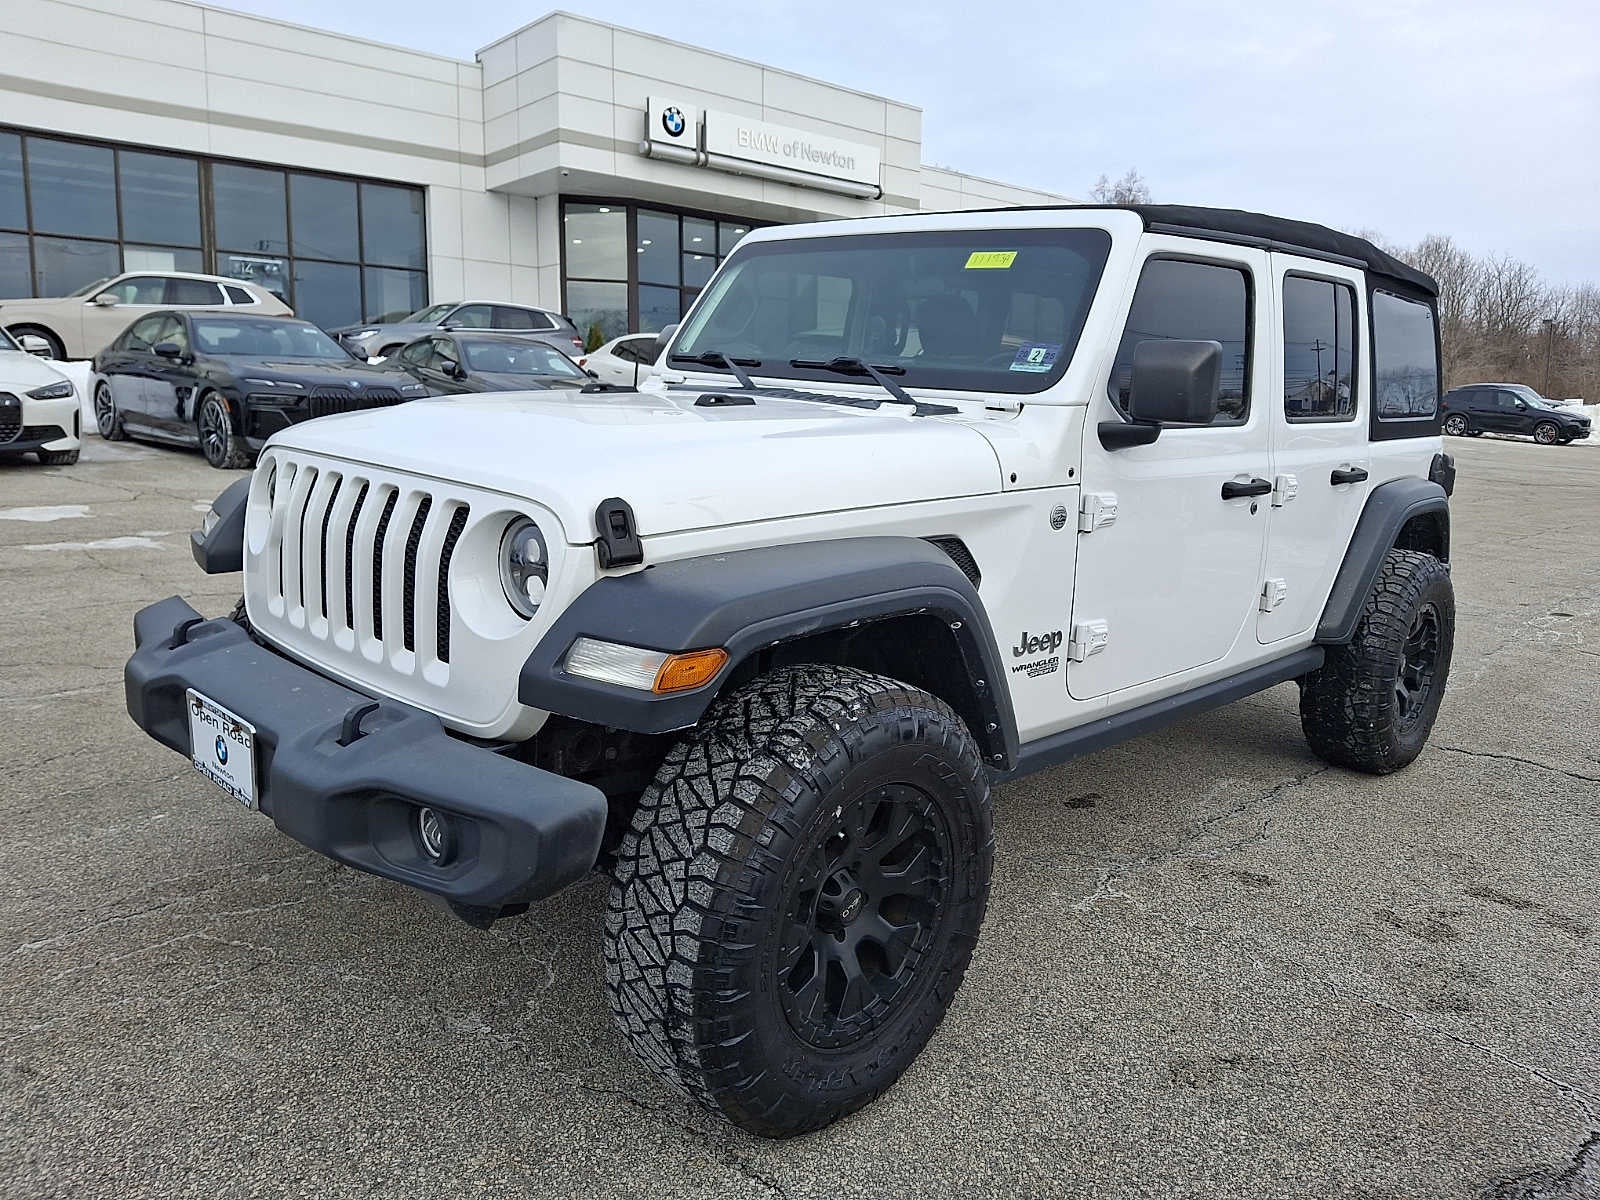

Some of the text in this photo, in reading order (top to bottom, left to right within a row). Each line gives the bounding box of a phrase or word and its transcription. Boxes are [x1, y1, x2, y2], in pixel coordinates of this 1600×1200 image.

[737, 127, 856, 170] BMW of Newton
[1031, 350, 1041, 361] 2
[1012, 630, 1063, 657] Jeep
[1011, 656, 1059, 673] WRANGLER
[191, 703, 219, 729] Open
[213, 774, 232, 794] ROAD
